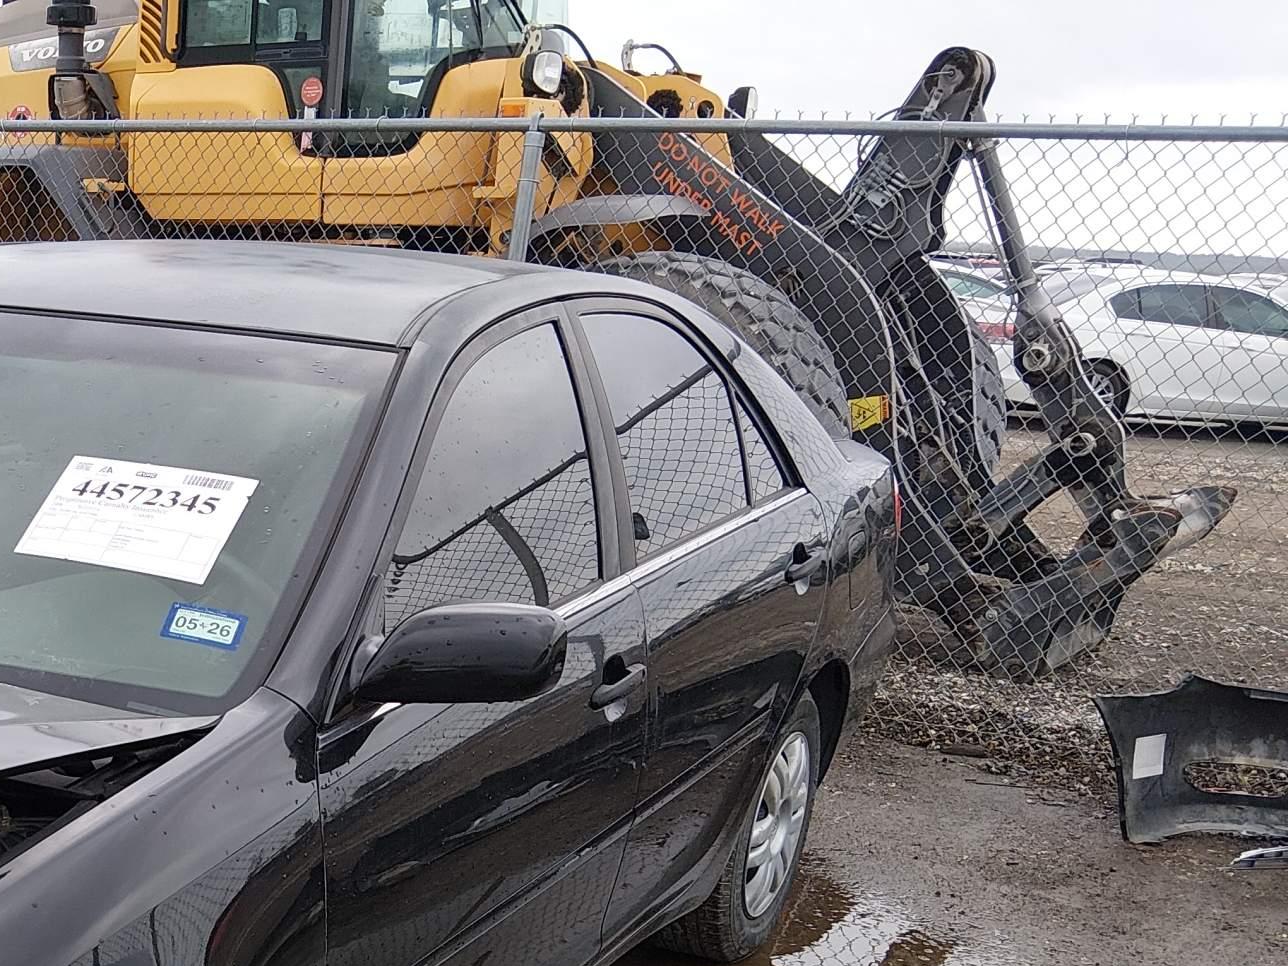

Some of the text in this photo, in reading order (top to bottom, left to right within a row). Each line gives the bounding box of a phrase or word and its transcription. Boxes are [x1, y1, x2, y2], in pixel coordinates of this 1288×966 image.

[22, 39, 105, 62] VOO
[657, 131, 785, 239] DO NOT WALK
[710, 211, 764, 256] MAST
[71, 479, 221, 515] 44572345
[174, 615, 200, 631] 05
[207, 621, 233, 638] 26
